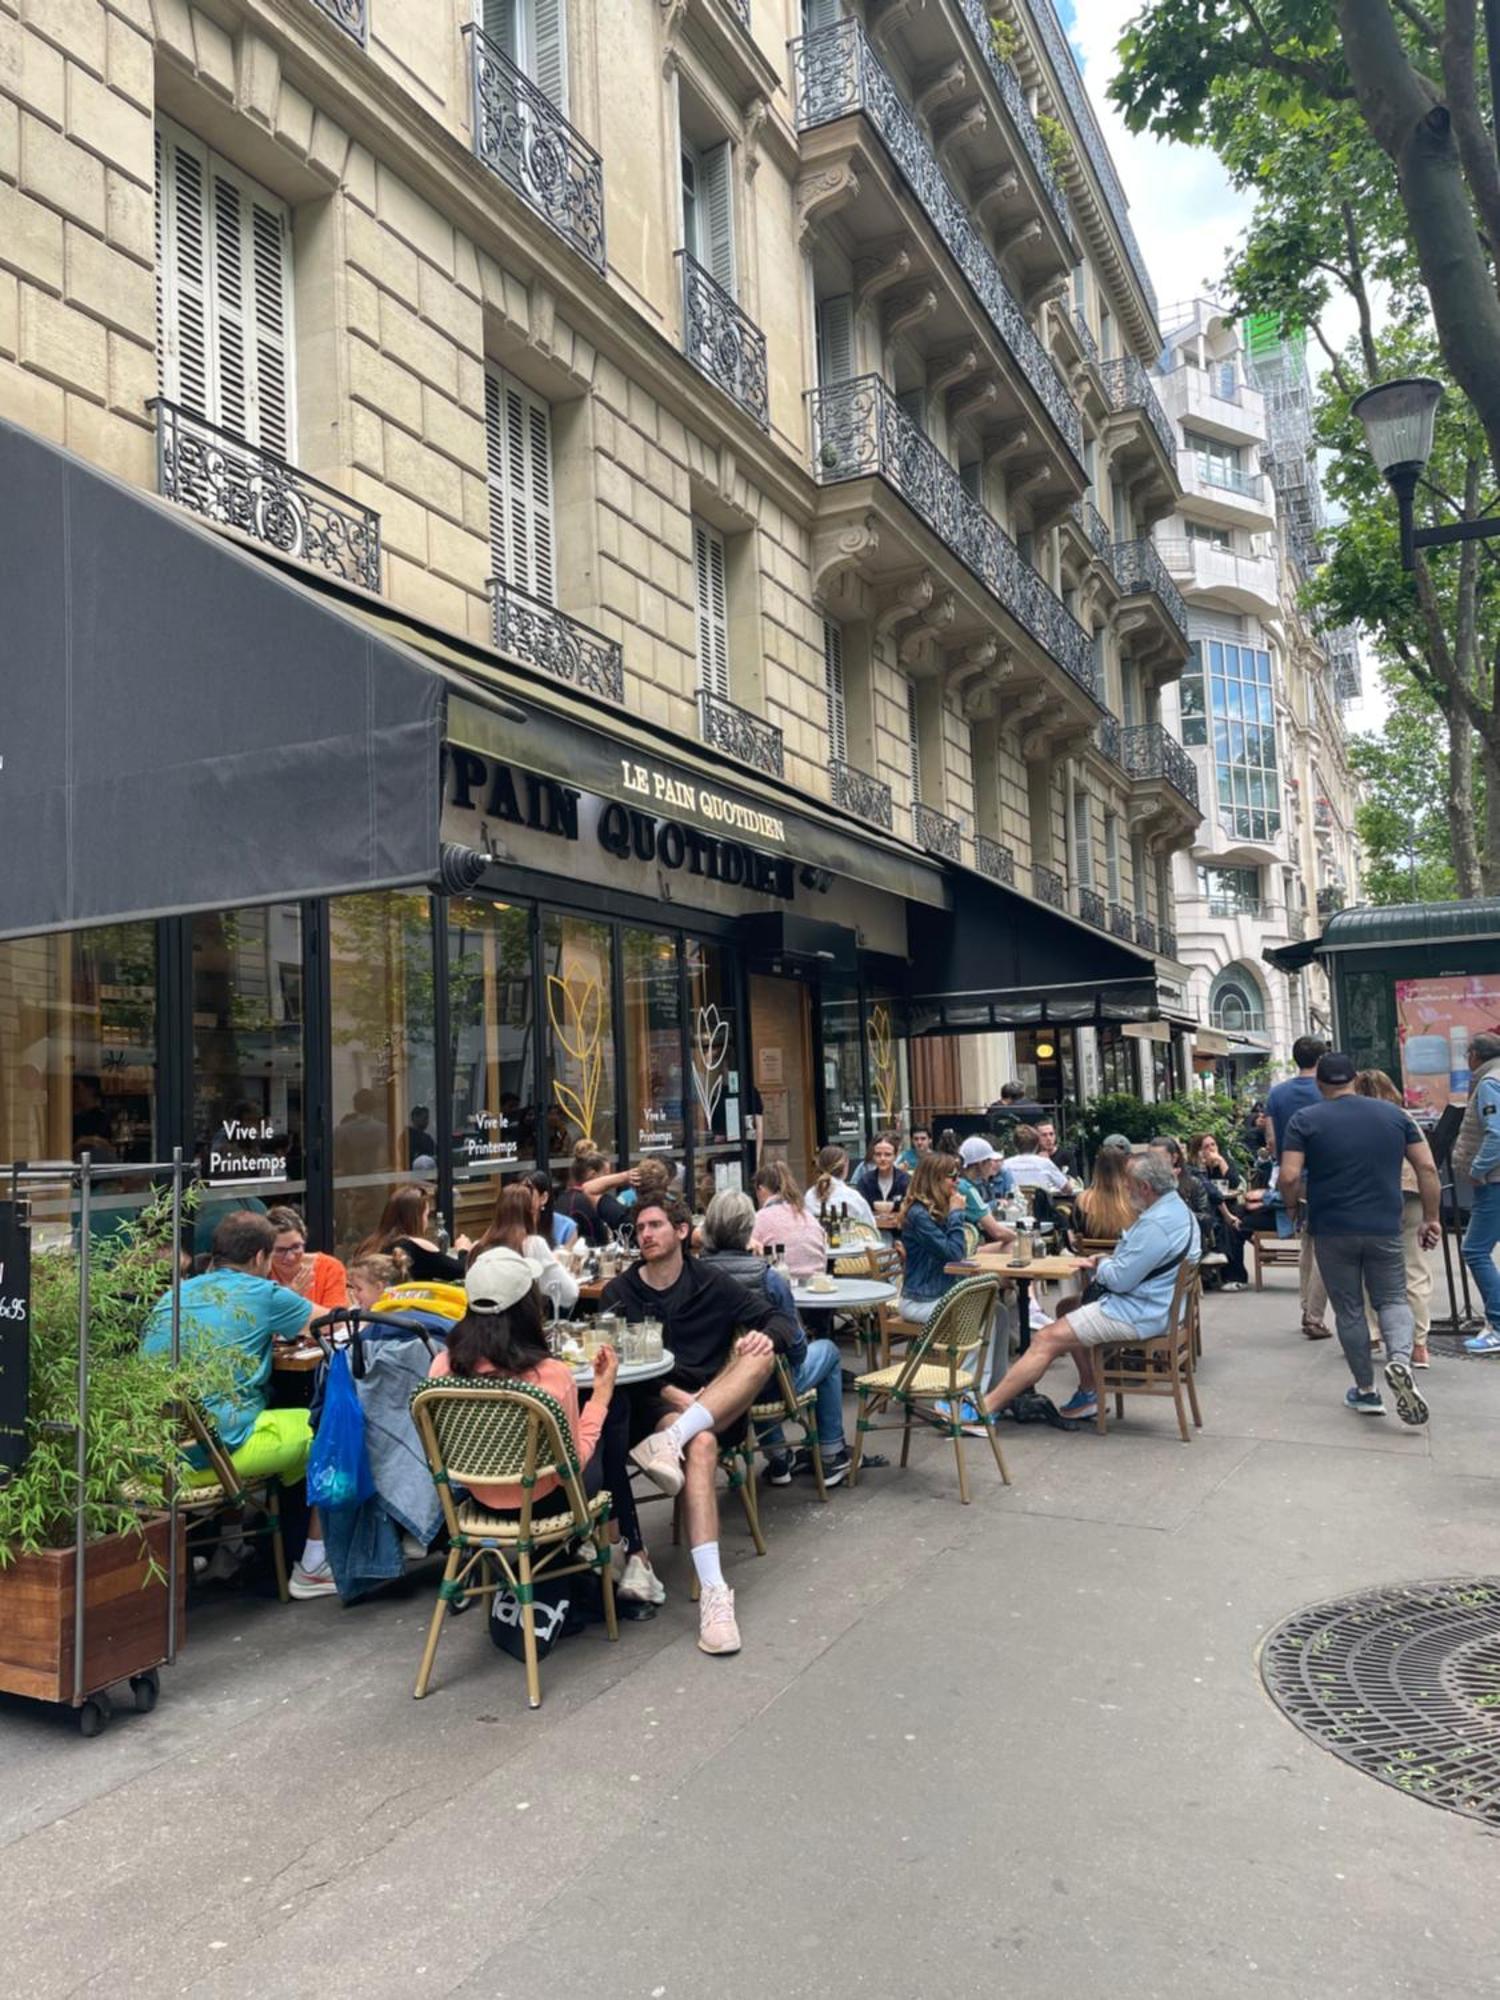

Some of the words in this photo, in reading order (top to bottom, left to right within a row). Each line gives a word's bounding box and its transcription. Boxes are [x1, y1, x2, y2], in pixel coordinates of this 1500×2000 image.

[450, 750, 581, 841] PAIN
[621, 760, 650, 796] LE
[652, 772, 696, 812] PAIN
[699, 791, 785, 842] QUOTIDIEN
[223, 1119, 257, 1140] Vive
[261, 1119, 274, 1139] le
[475, 1112, 498, 1130] Vive
[499, 1112, 509, 1129] le
[468, 1139, 518, 1158] Printemps
[210, 1152, 287, 1177] Printemps
